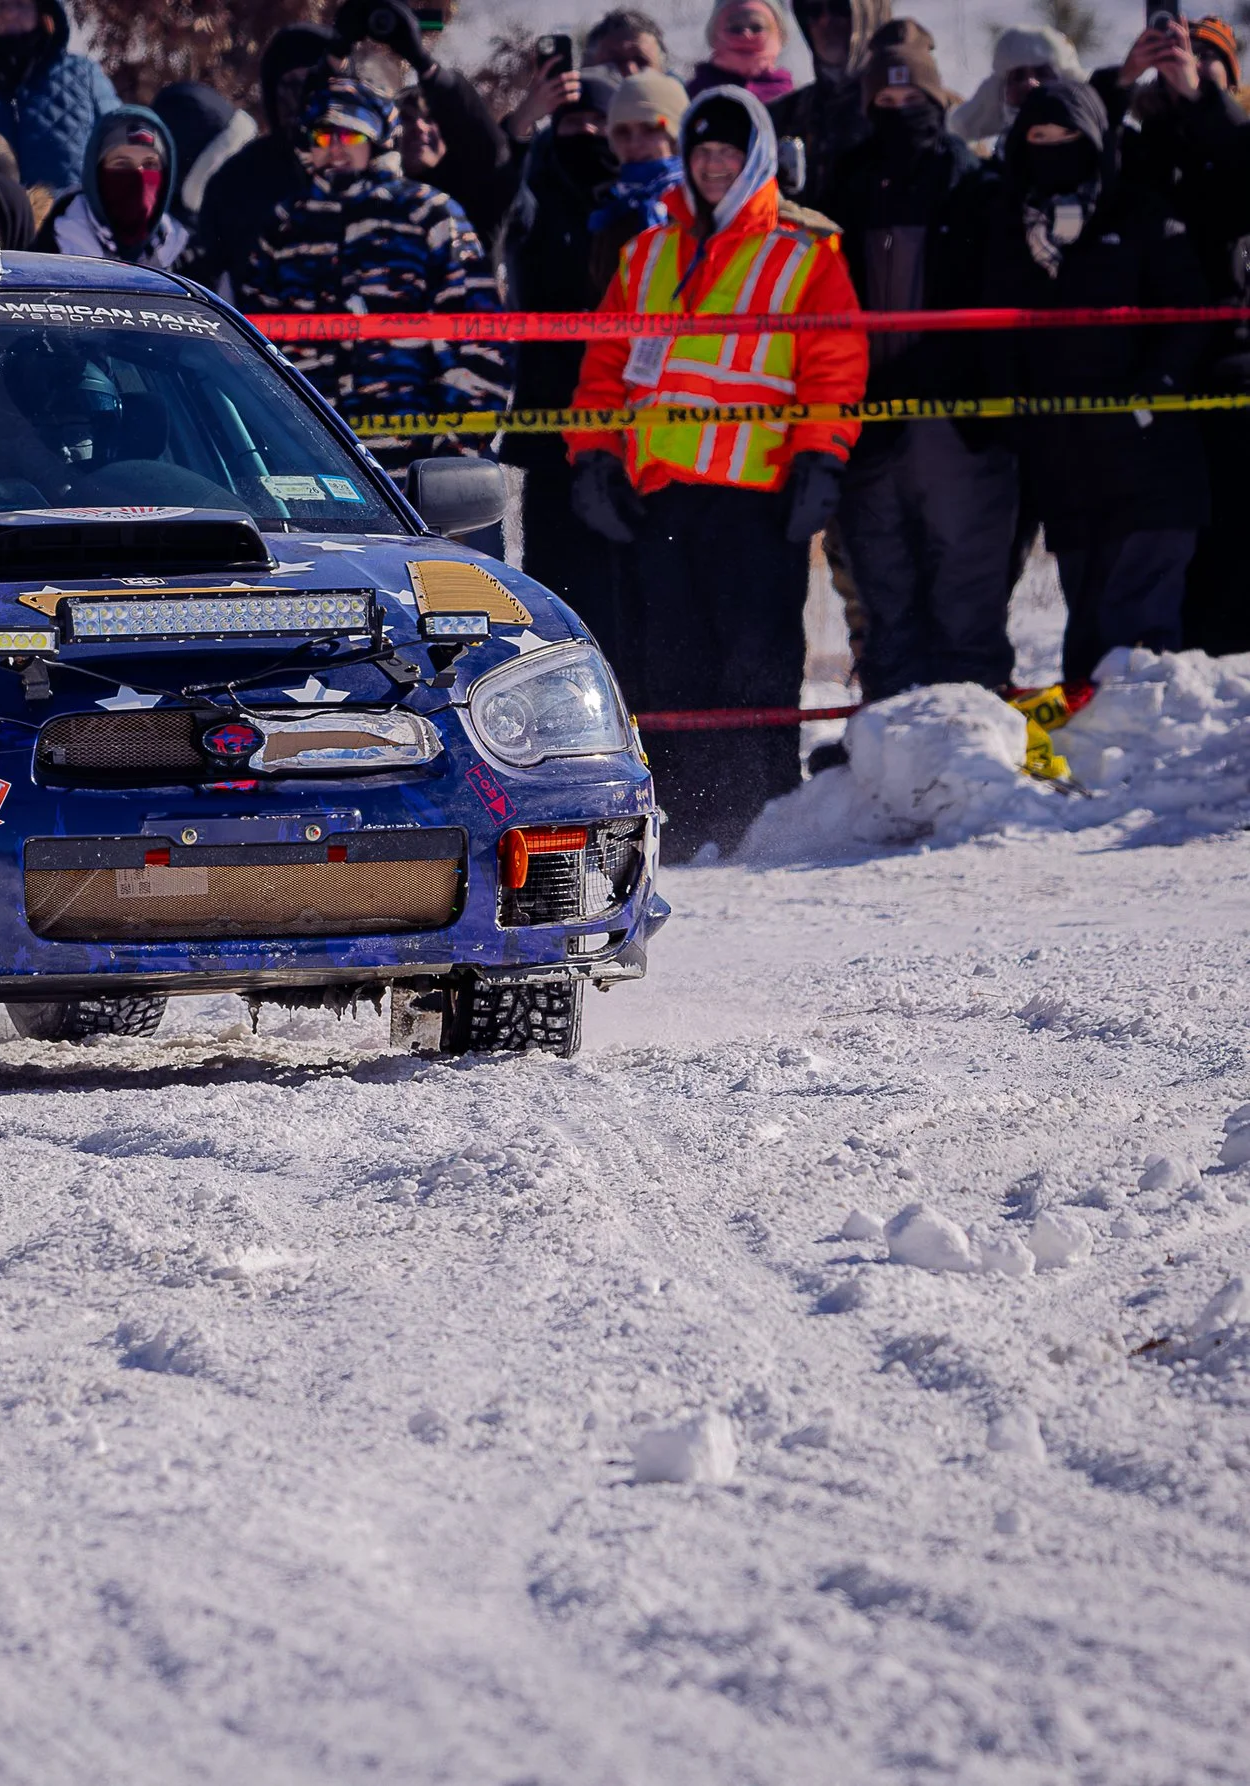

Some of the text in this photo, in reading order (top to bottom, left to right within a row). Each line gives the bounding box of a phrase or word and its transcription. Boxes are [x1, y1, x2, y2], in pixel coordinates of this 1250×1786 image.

[139, 310, 221, 331] RALLY
[494, 408, 637, 428] CAUTION
[665, 404, 810, 424] CAUTION
[839, 399, 980, 418] CAUTION
[348, 411, 464, 432] CAUTIO
[474, 769, 498, 800] TOW
